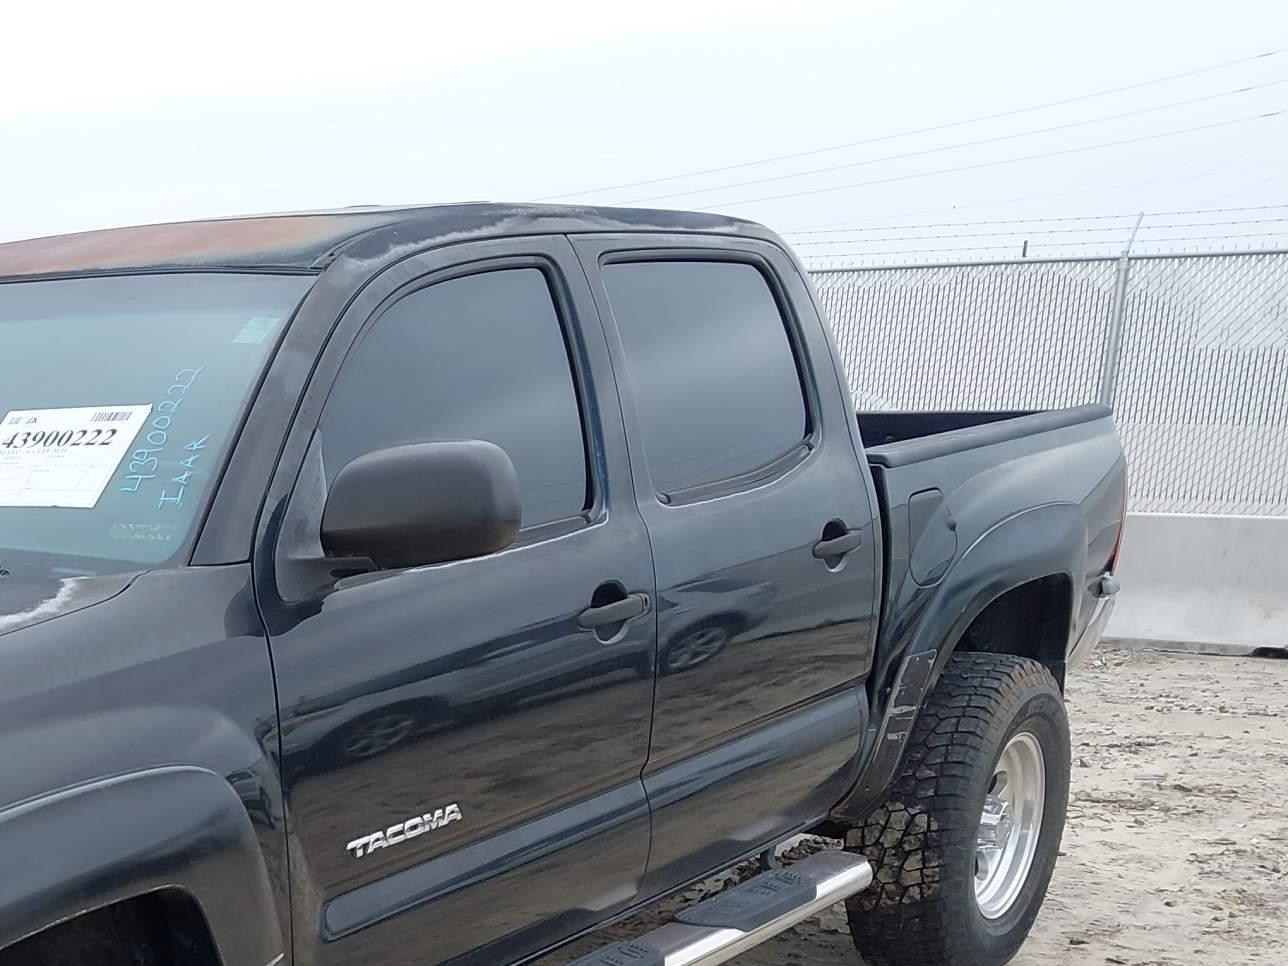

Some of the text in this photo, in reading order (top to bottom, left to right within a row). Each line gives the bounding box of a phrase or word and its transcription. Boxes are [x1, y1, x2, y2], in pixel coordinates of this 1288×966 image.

[1, 428, 118, 449] 43900222
[119, 364, 207, 492] 43900222
[345, 802, 463, 859] TACOMA
